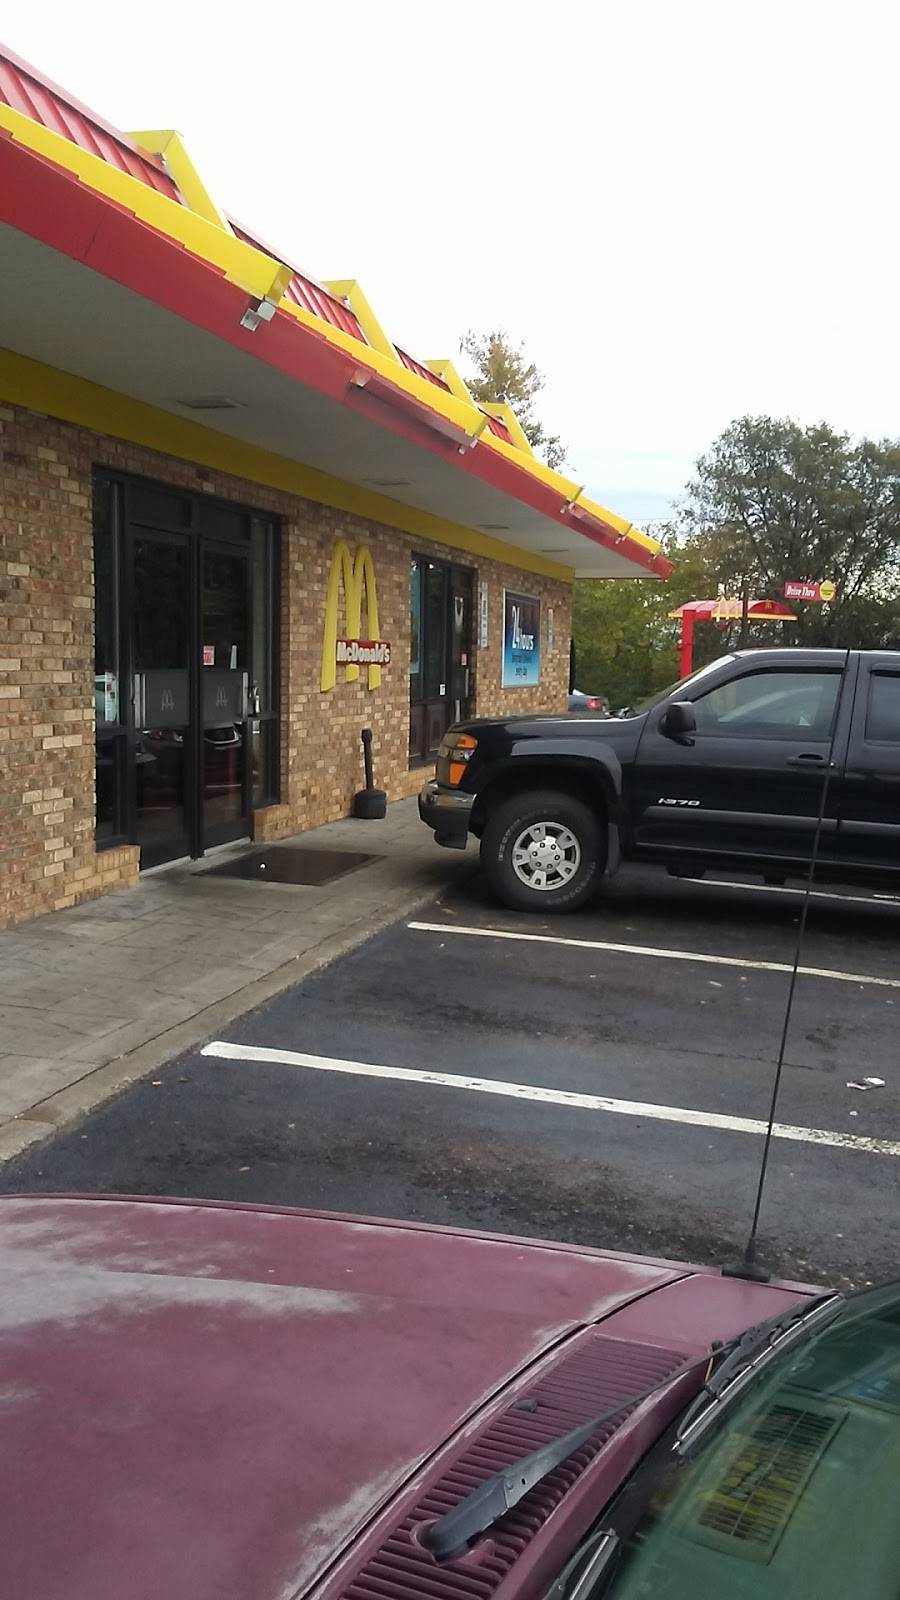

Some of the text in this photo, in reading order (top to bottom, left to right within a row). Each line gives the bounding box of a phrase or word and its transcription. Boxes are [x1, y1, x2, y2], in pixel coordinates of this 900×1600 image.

[786, 585, 801, 596] Drive
[802, 586, 816, 597] Thru
[336, 641, 391, 663] McDonald's
